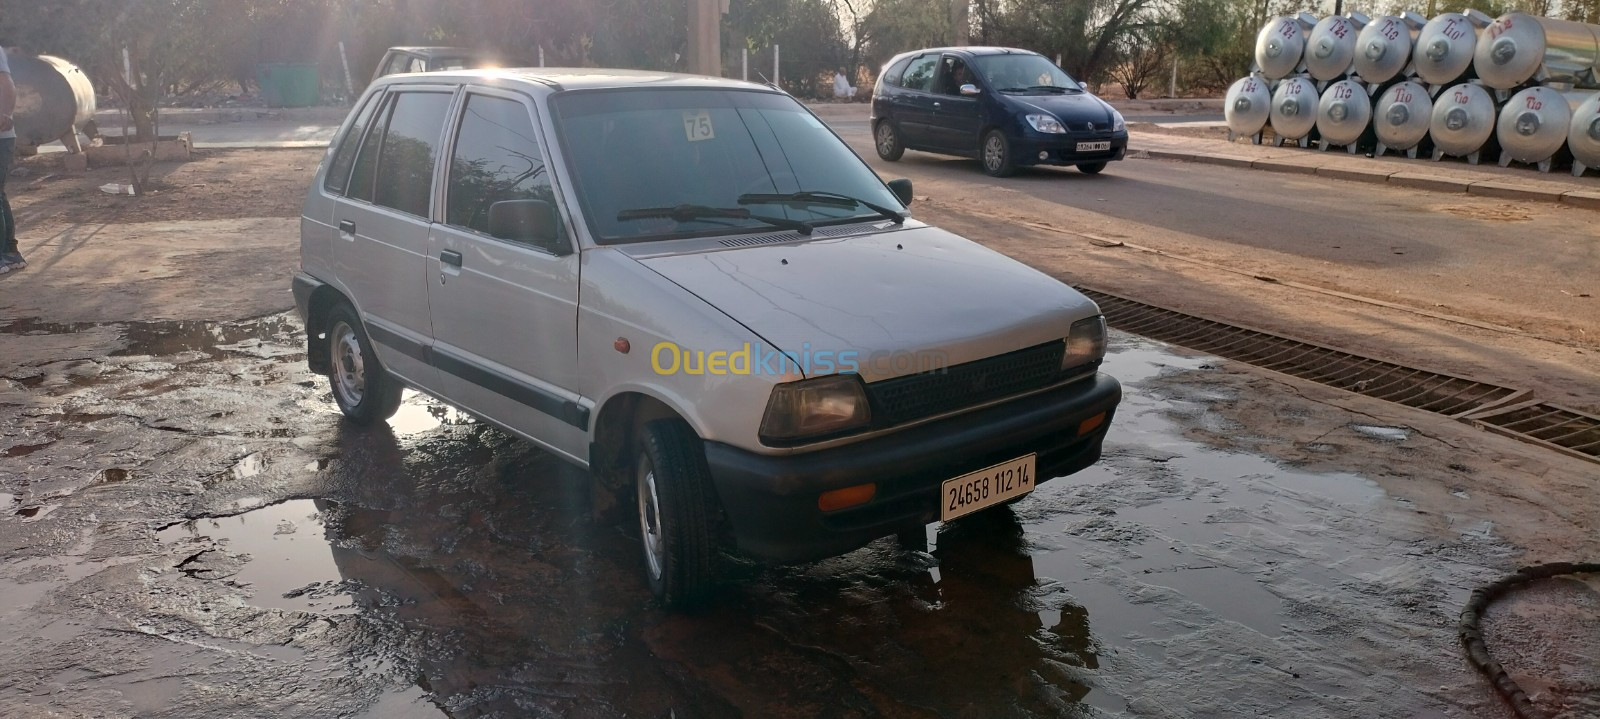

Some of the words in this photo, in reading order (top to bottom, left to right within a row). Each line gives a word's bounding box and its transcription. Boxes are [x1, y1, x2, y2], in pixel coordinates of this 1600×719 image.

[1334, 86, 1352, 99] T10
[1394, 88, 1412, 102] T10
[1454, 91, 1469, 105] T10
[1526, 96, 1542, 111] T10
[687, 117, 711, 138] 75
[949, 477, 989, 511] 24658
[995, 470, 1013, 494] 112
[1017, 464, 1029, 487] 14
